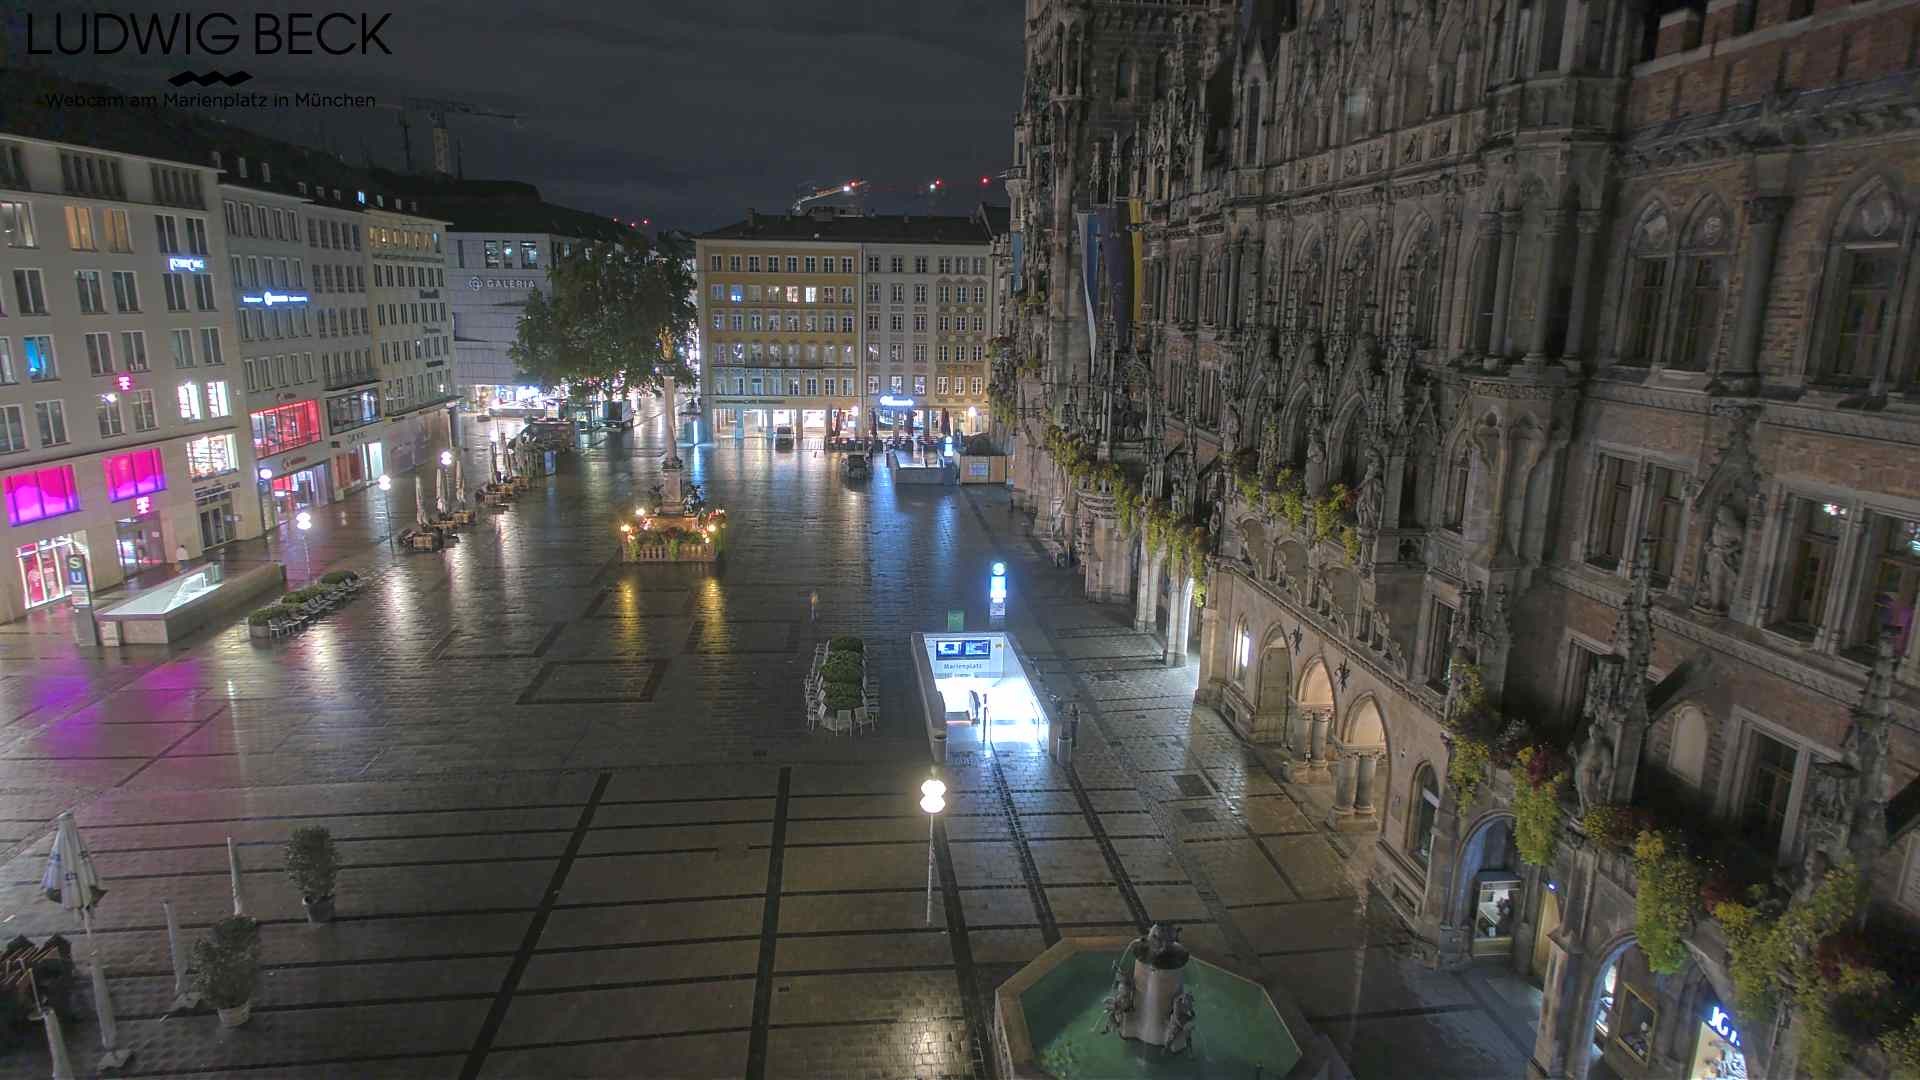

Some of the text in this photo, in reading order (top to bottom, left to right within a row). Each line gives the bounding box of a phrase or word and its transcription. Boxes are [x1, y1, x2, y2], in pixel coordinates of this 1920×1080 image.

[487, 280, 536, 289] GALERIA
[69, 556, 81, 569] S
[71, 571, 82, 584] U
